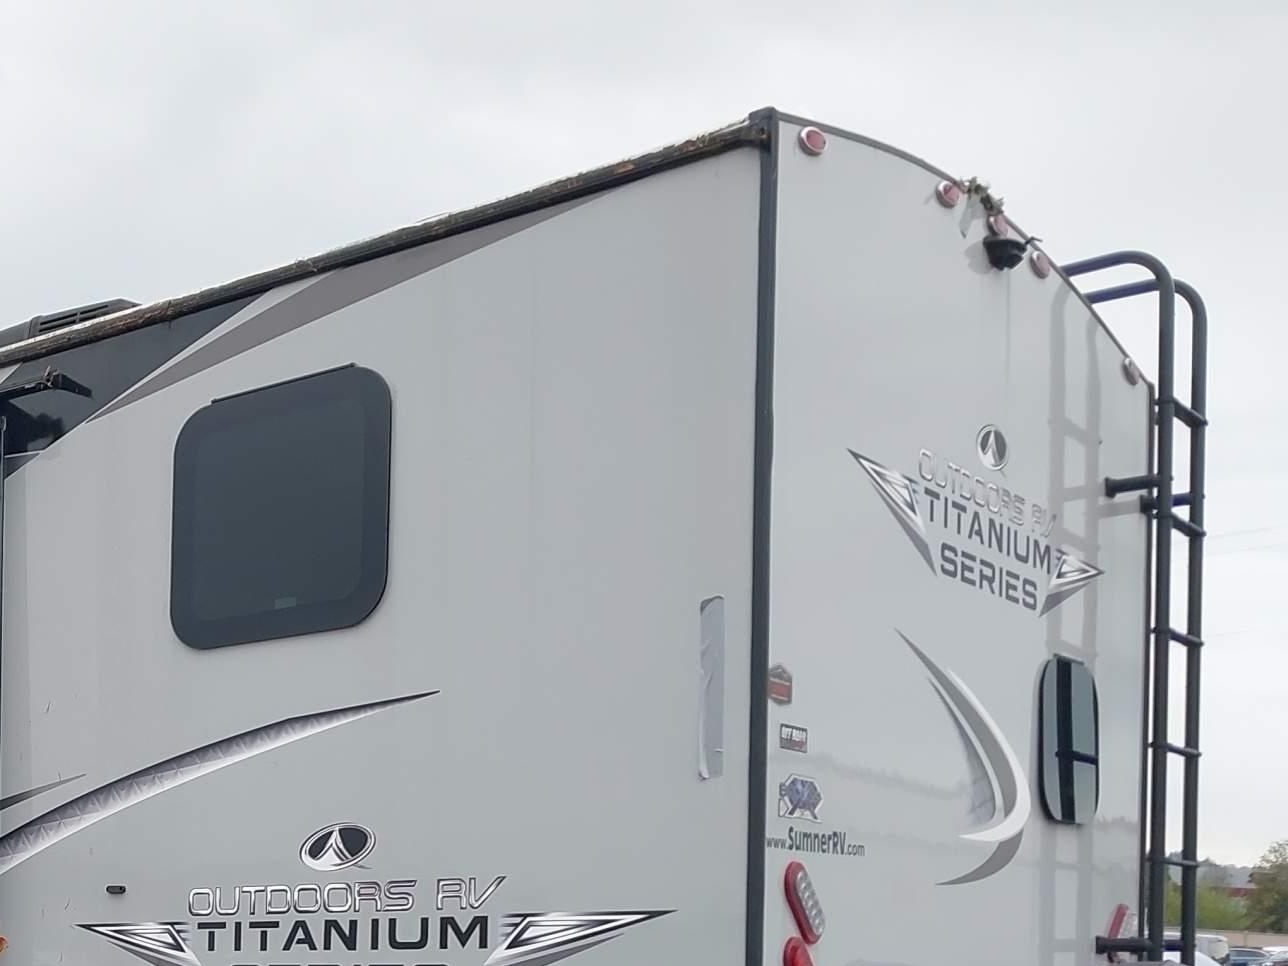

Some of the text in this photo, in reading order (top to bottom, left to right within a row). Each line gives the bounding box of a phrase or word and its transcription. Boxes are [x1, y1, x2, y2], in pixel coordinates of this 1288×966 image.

[924, 486, 1051, 575] TITANIUM
[940, 542, 1038, 611] SERIES
[766, 826, 866, 857] www.SumnerRV.com
[188, 875, 507, 916] OUTDOORS RV
[197, 915, 489, 952] TITANIUM
